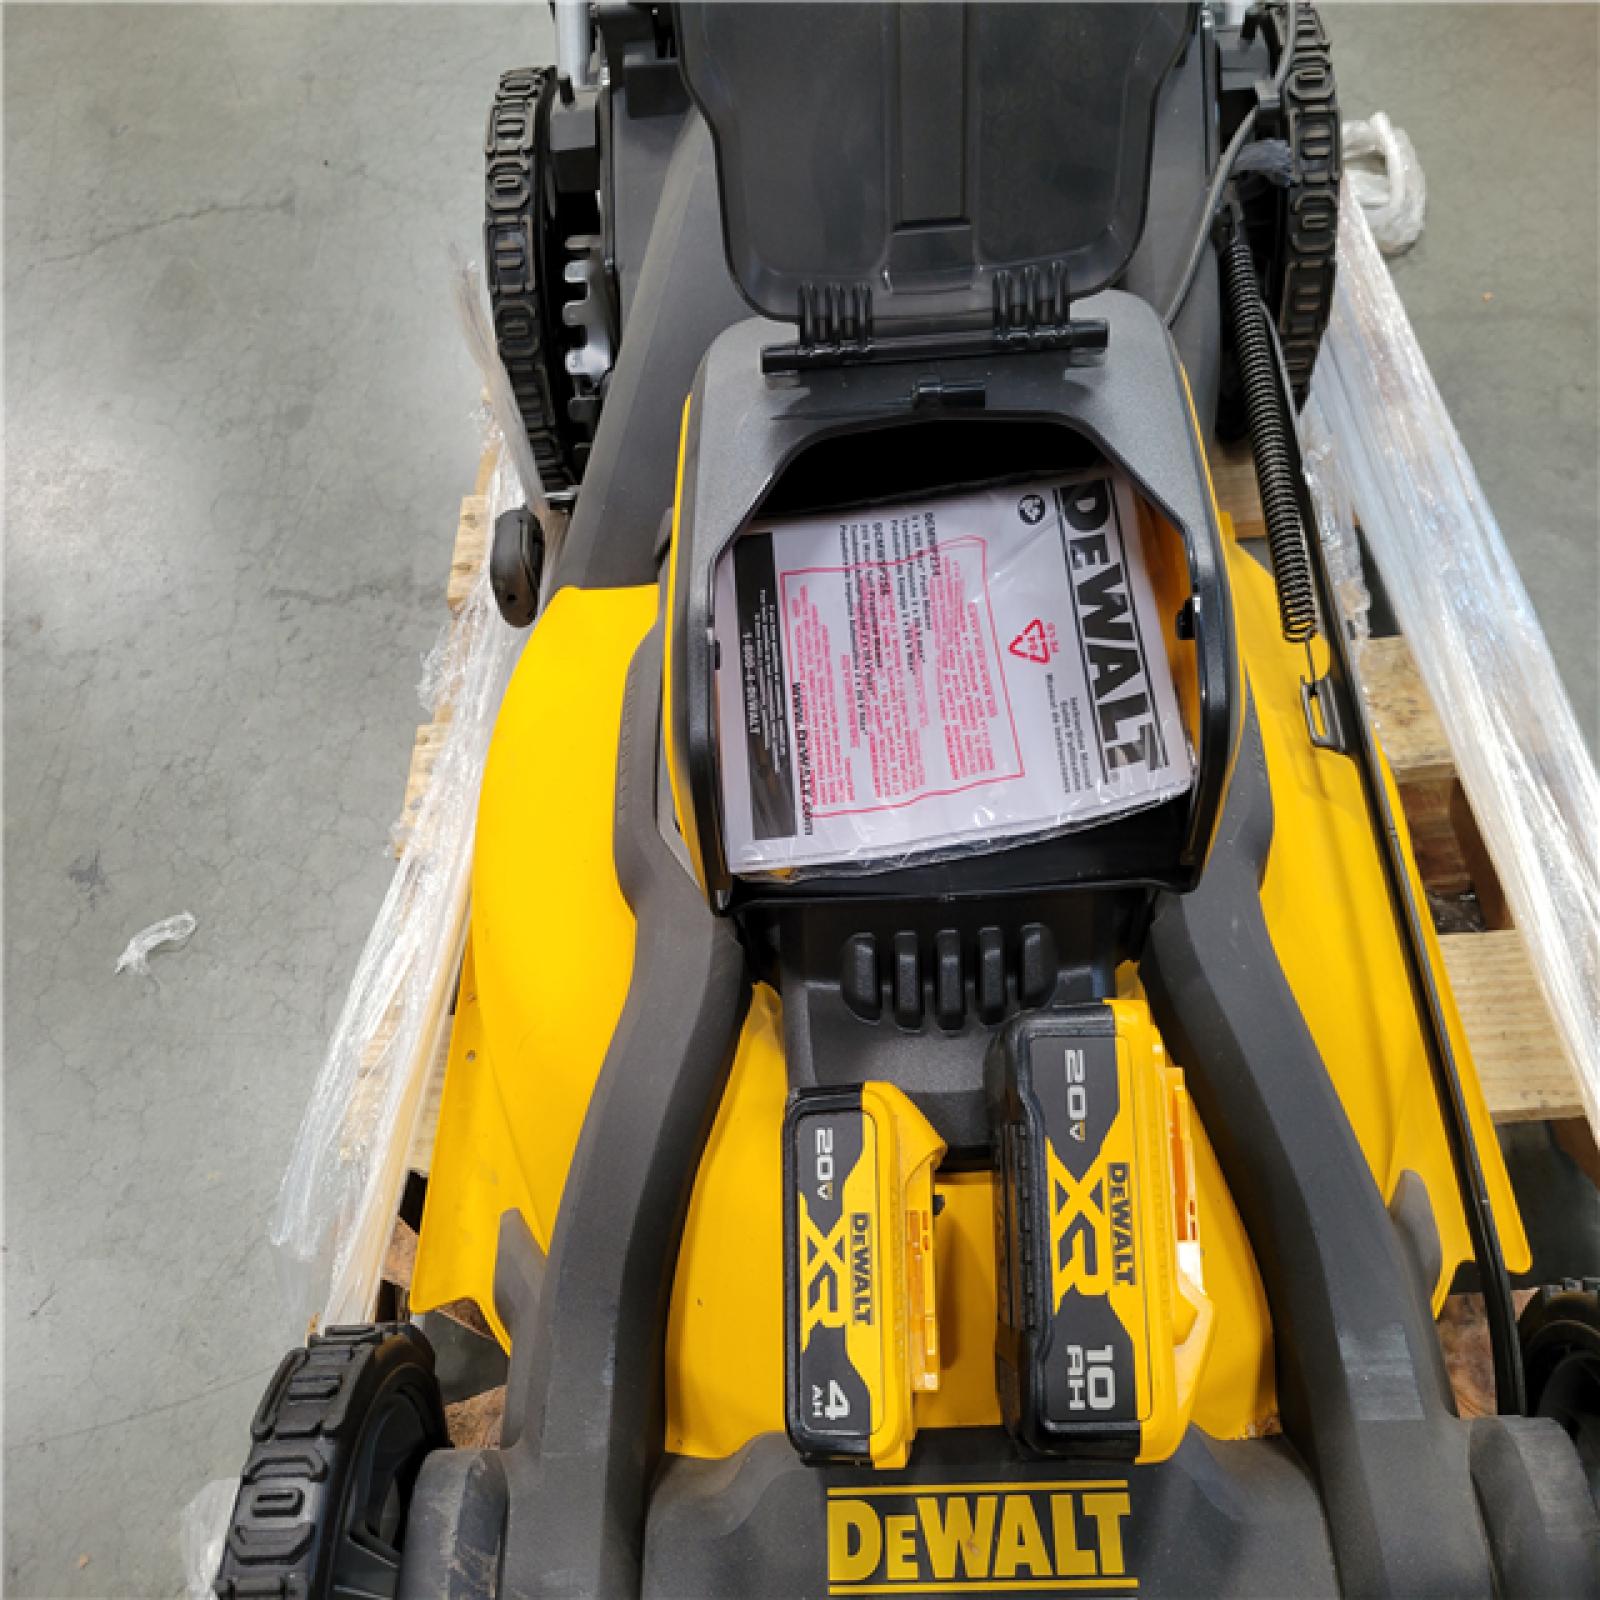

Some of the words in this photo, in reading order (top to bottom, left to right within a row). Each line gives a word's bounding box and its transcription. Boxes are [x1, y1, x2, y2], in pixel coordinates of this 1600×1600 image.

[1059, 480, 1160, 772] DEWALT
[801, 1194, 849, 1350] XR
[849, 1211, 874, 1327] DEWALT
[1048, 1143, 1109, 1312] XR
[1107, 1162, 1137, 1286] DEWALT
[824, 1379, 851, 1421] 4
[1066, 1344, 1086, 1412] AH
[1085, 1344, 1117, 1411] 10
[827, 1492, 1131, 1582] DEWALT
